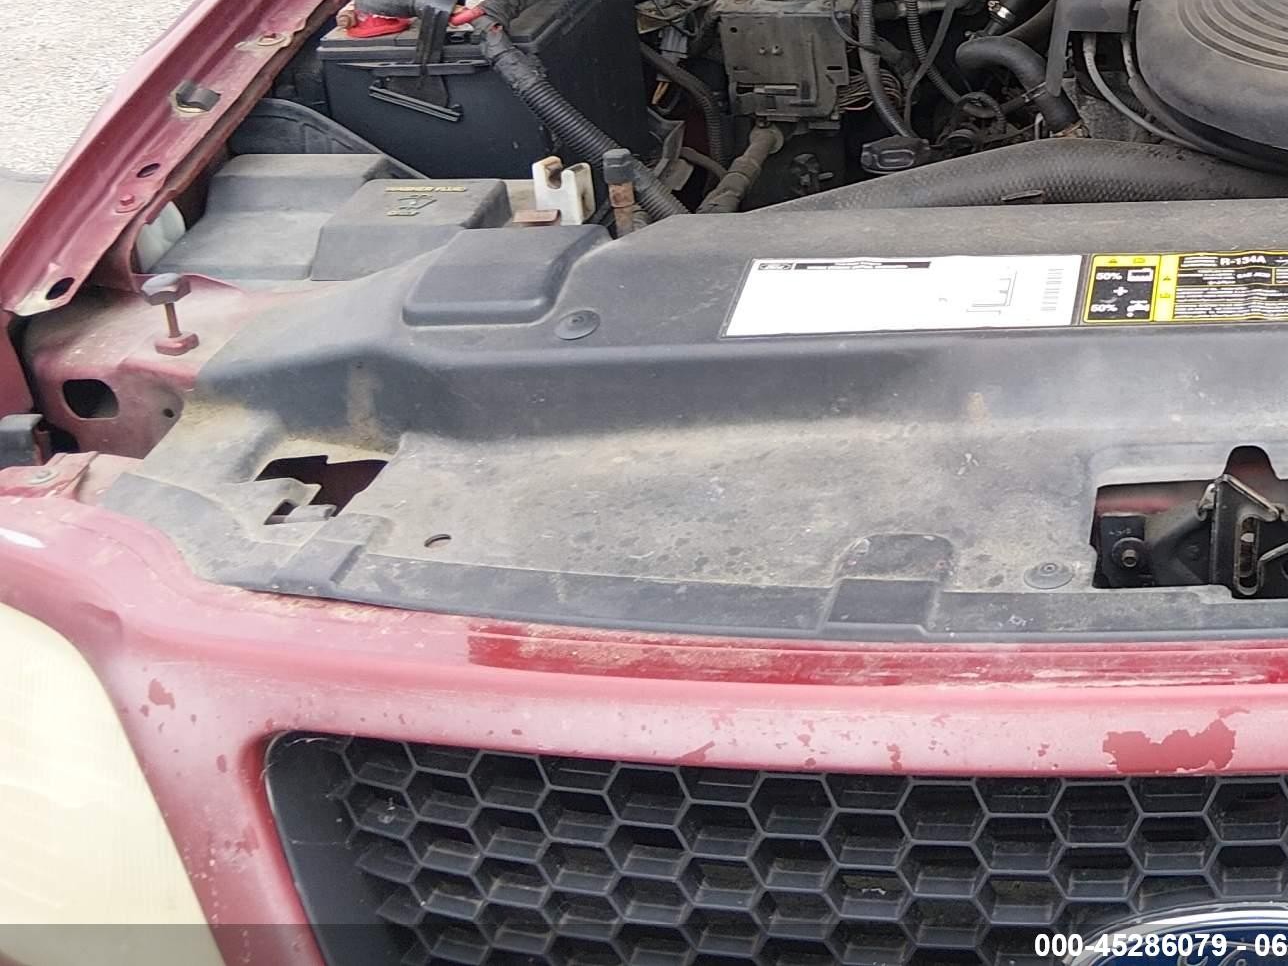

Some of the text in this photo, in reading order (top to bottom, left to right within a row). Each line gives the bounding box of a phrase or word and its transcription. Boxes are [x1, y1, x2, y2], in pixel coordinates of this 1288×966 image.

[1219, 255, 1267, 266] R-134A
[1095, 272, 1123, 280] 50%
[1090, 303, 1119, 313] 50%
